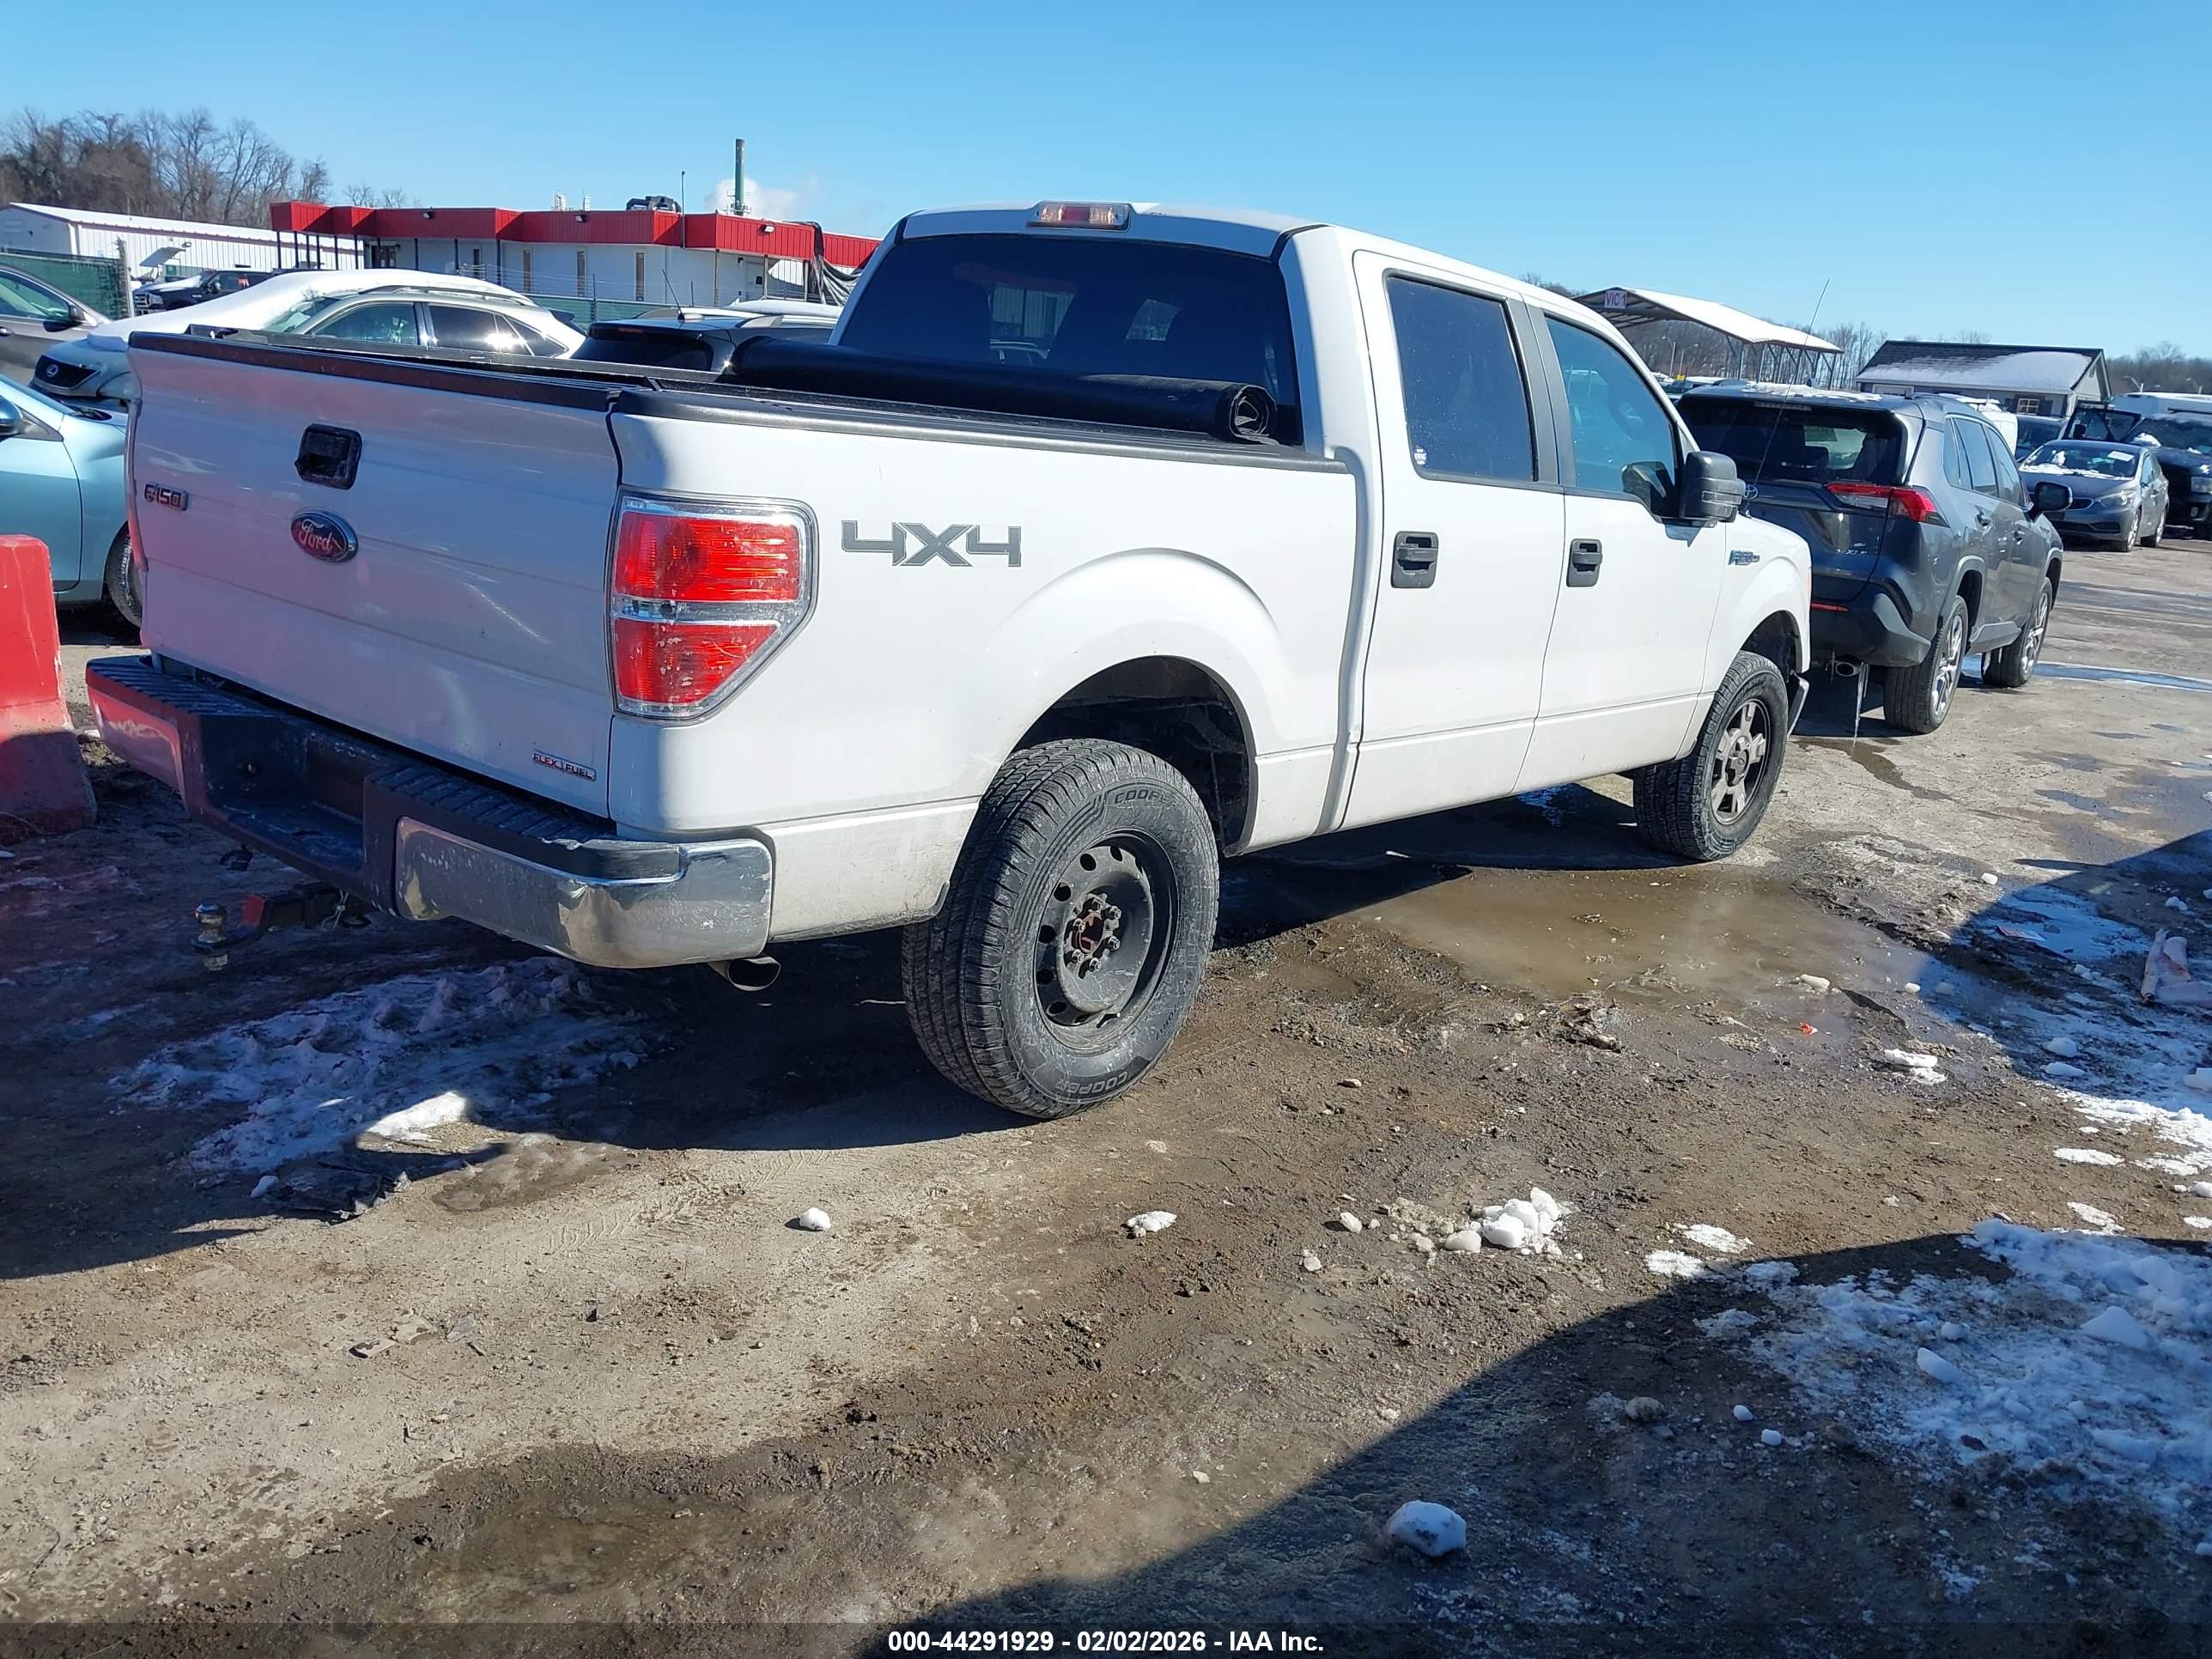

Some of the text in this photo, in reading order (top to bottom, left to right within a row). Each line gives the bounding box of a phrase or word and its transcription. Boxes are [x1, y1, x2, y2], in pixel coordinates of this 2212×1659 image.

[1607, 292, 1620, 306] VIC
[298, 518, 333, 551] Ford
[533, 752, 594, 780] FLEX FUEL
[1054, 1071, 1128, 1095] COOPER
